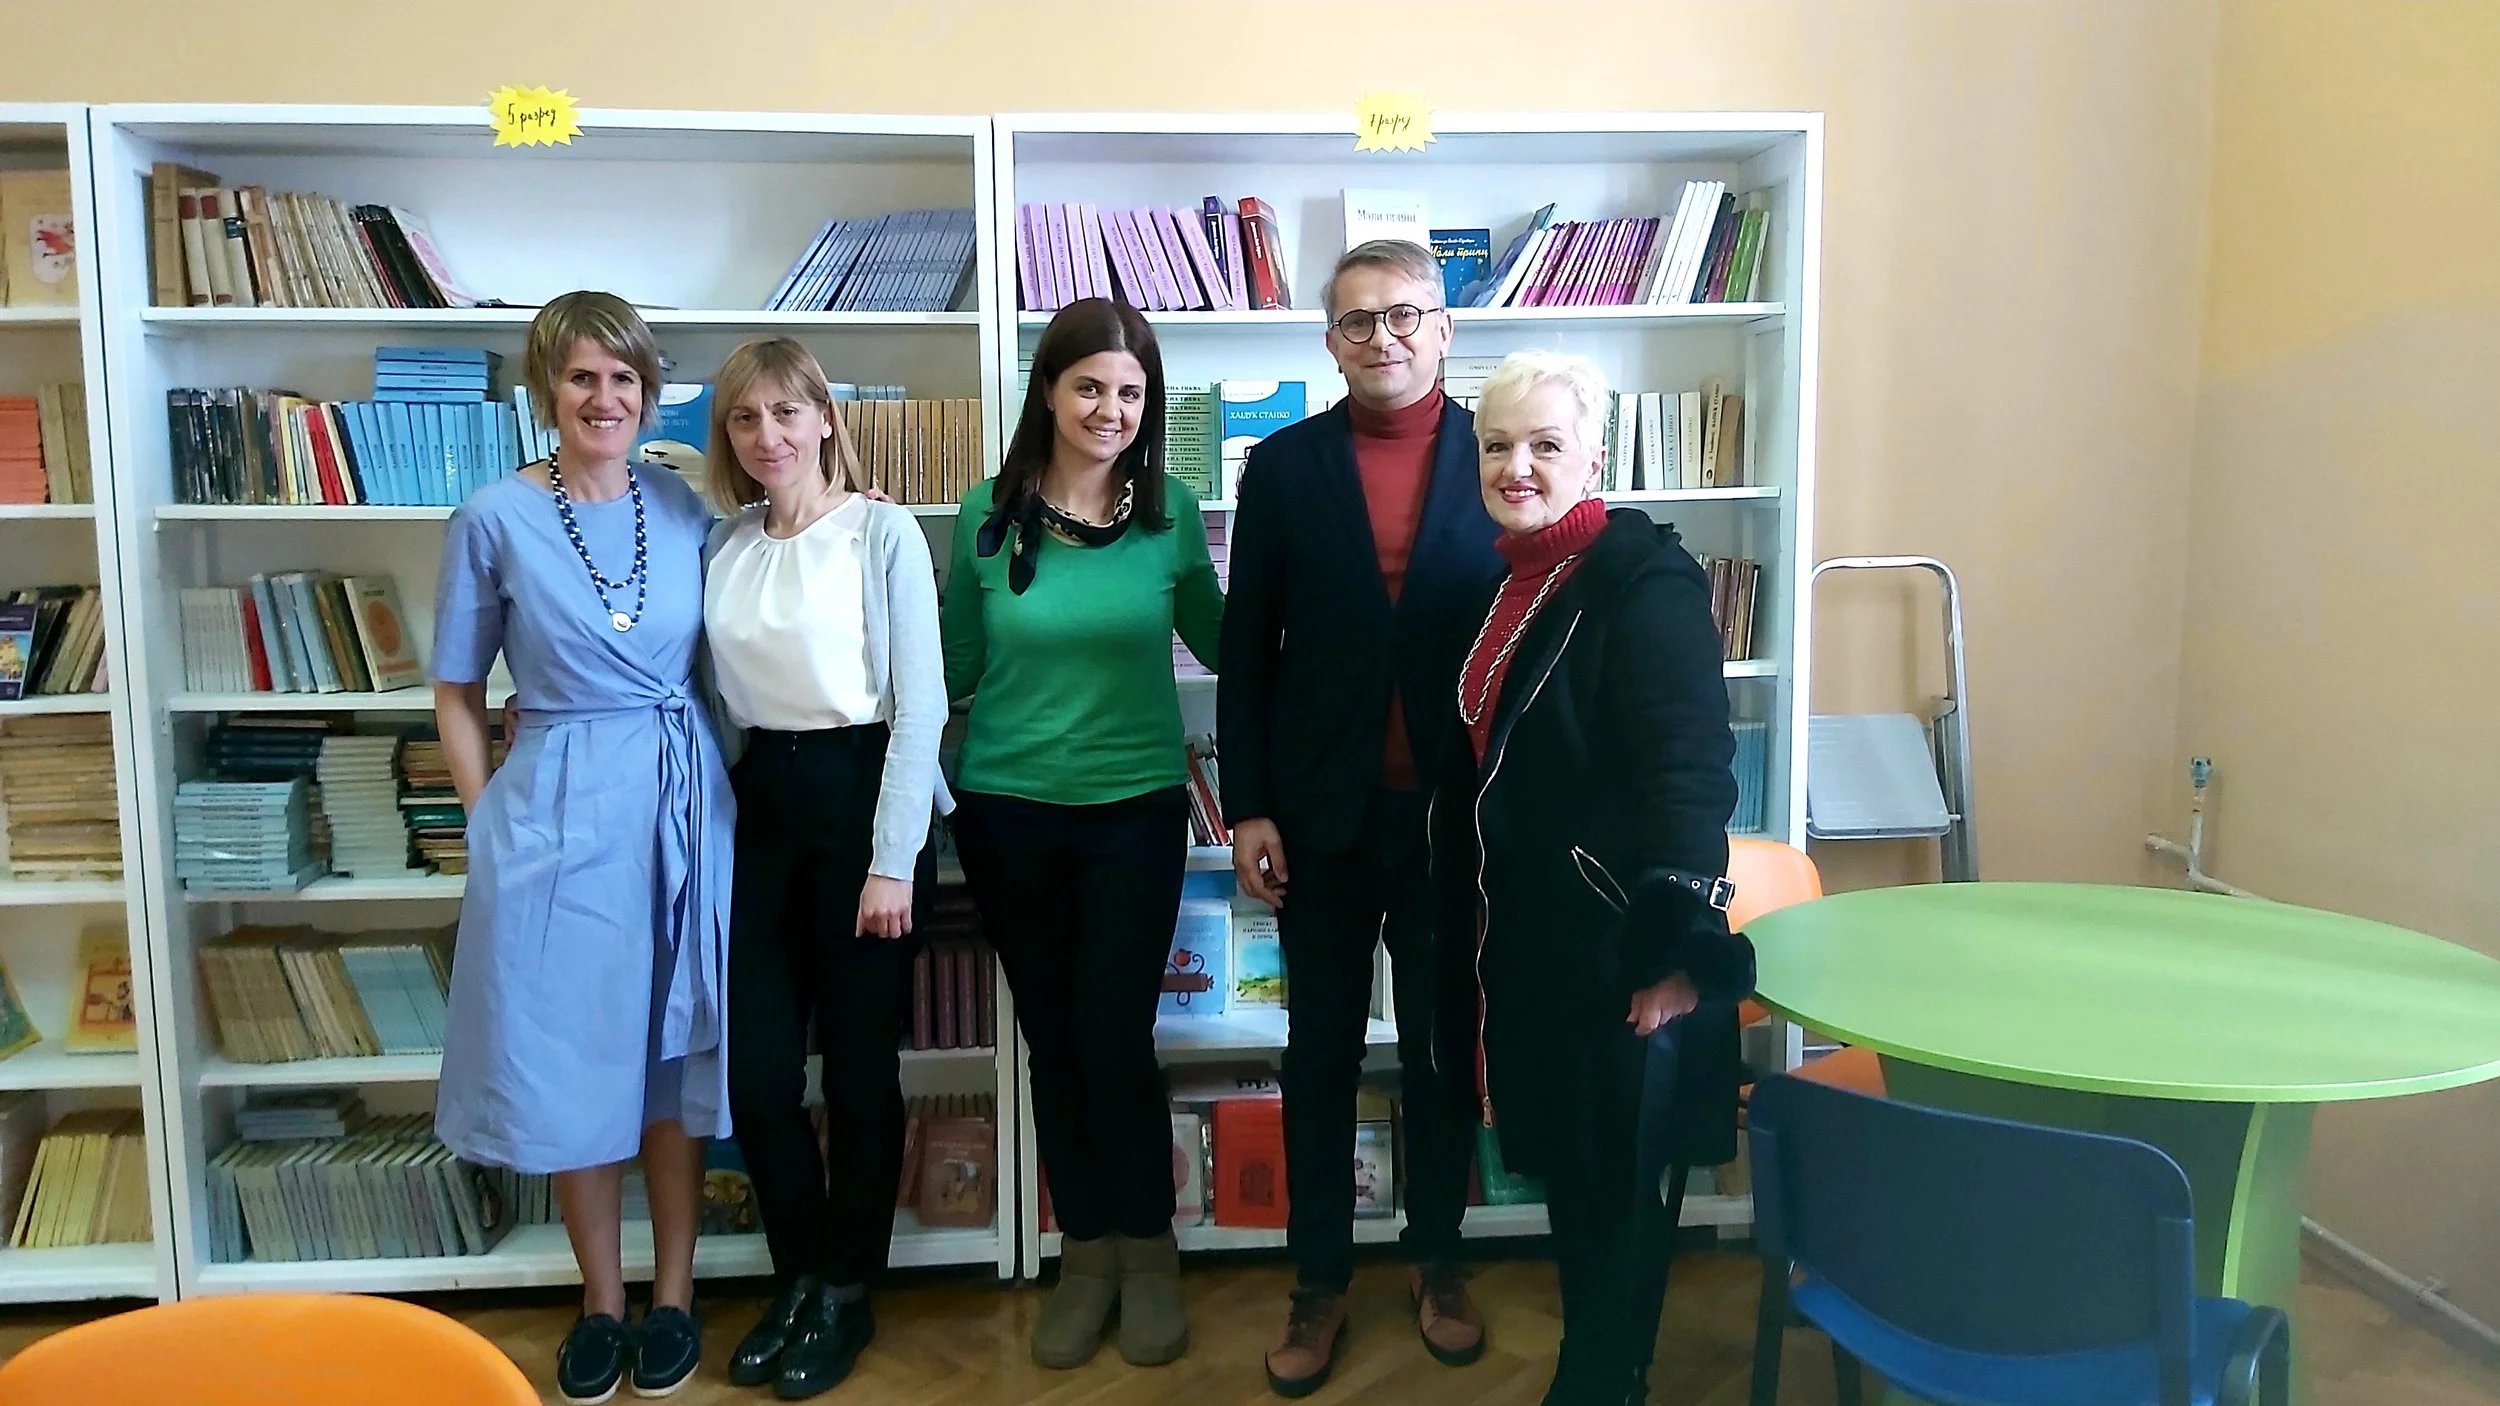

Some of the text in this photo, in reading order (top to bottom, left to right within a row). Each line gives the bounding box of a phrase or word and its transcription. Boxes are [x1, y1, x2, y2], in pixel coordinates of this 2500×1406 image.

[520, 106, 556, 132] разред
[1358, 209, 1382, 221] Мали
[1430, 246, 1455, 258] Мали
[1229, 411, 1290, 420] ХАЈДУК СТАНКО
